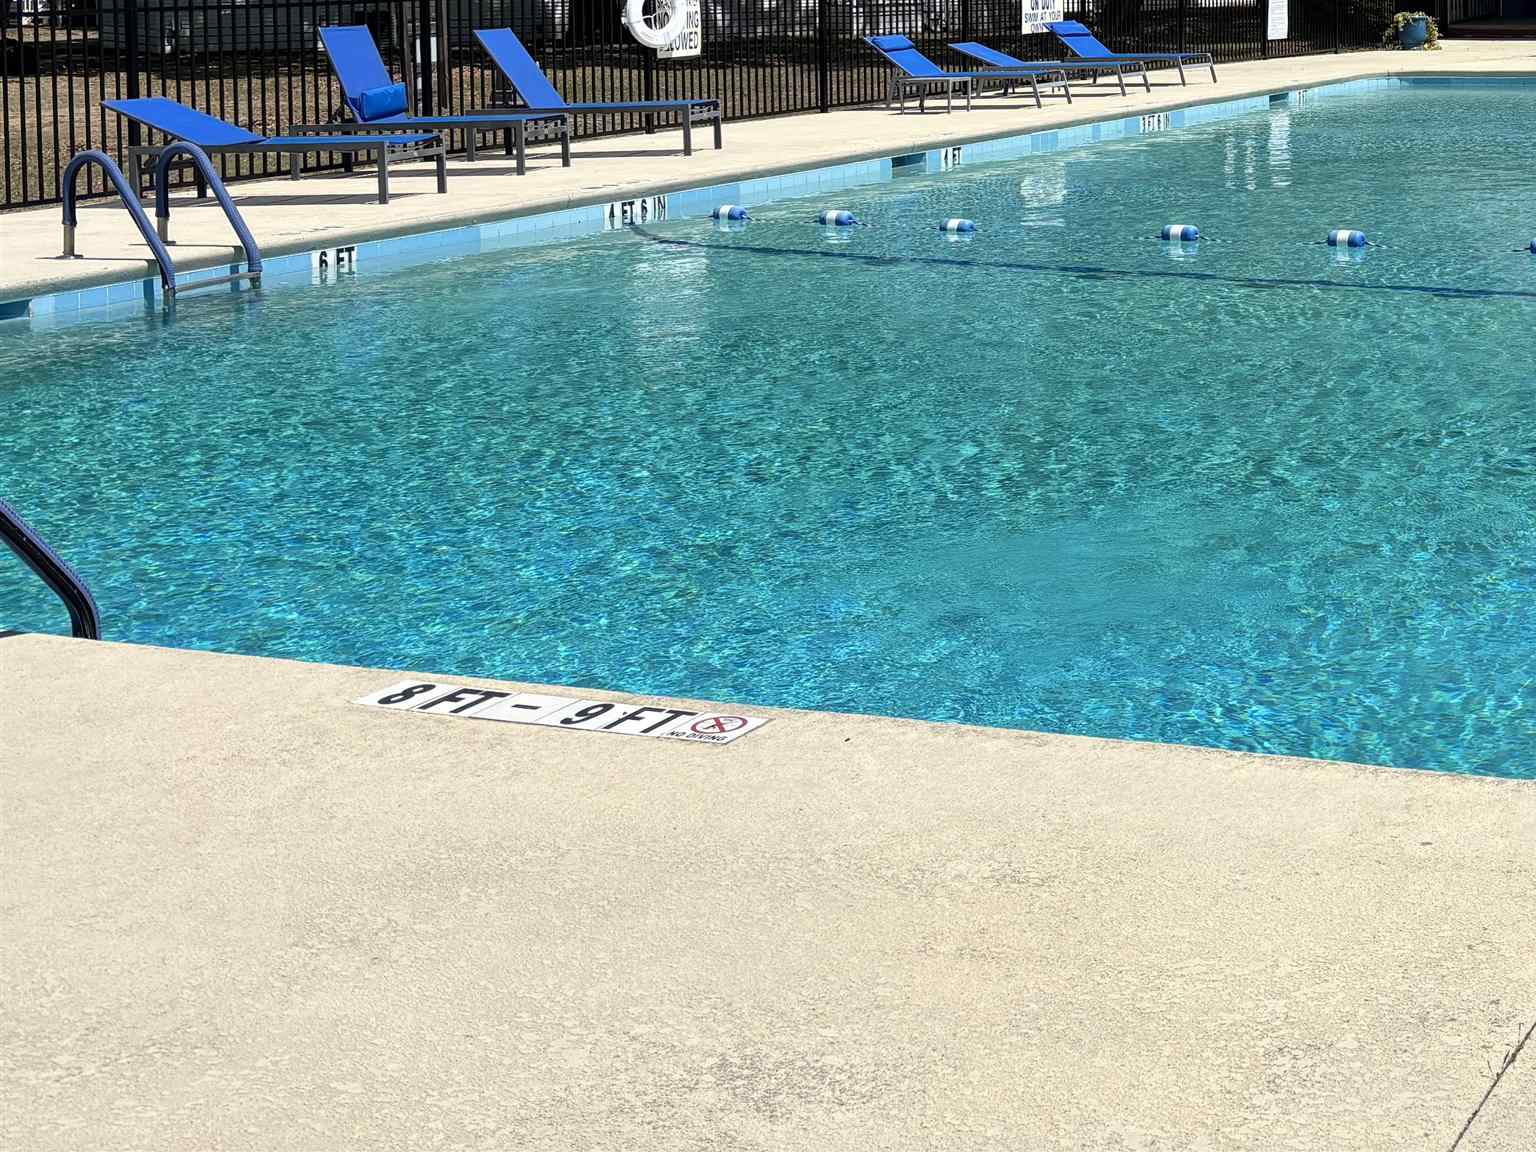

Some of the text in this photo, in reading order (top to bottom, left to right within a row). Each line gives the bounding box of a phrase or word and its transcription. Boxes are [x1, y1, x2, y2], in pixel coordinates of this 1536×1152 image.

[1024, 10, 1061, 24] SWIM AT YOUR
[652, 195, 667, 221] IN
[377, 683, 437, 705] 8
[417, 687, 513, 714] FT
[560, 703, 615, 725] 9
[603, 706, 699, 734] FT
[685, 732, 729, 741] DIVING
